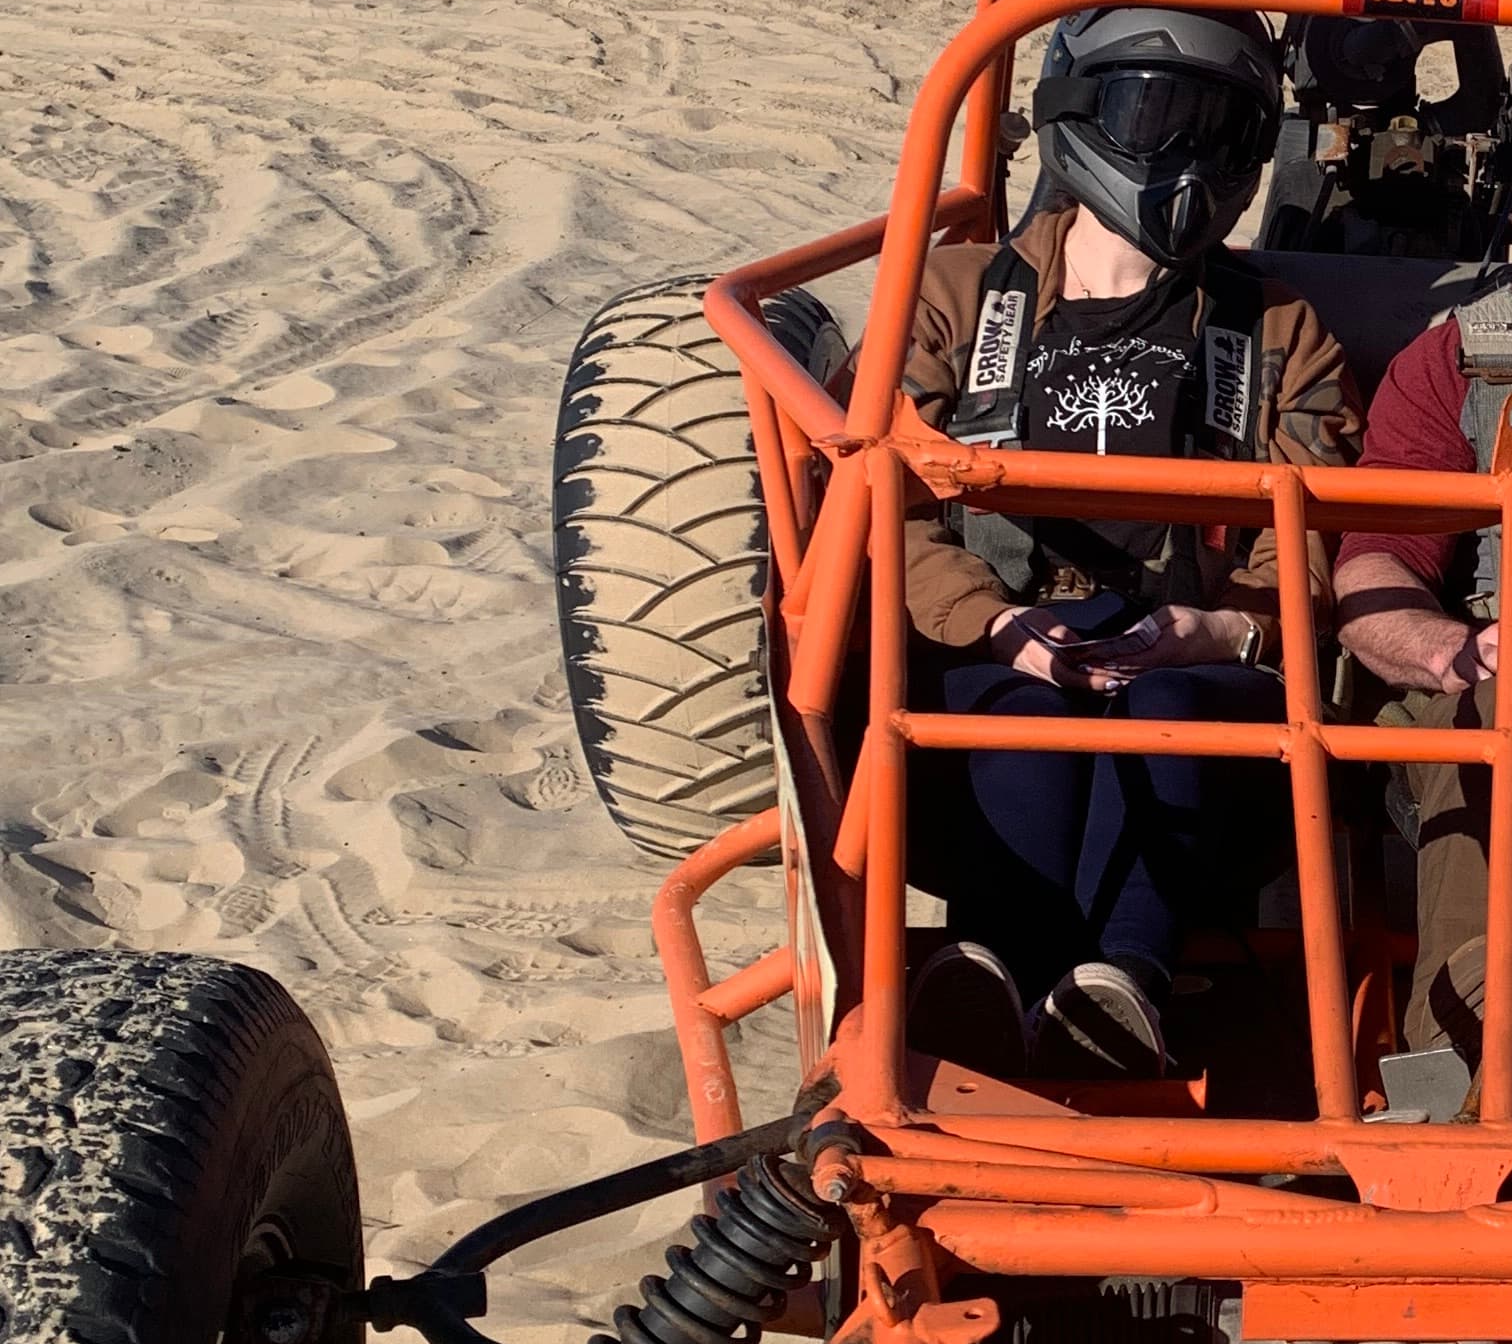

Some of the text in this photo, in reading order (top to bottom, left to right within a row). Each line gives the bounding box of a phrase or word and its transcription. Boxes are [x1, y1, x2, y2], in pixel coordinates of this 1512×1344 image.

[976, 318, 1002, 387] CROW
[995, 295, 1019, 383] SAFETY GEAR
[1213, 355, 1237, 428] CROW
[1231, 375, 1246, 433] SAFETY
